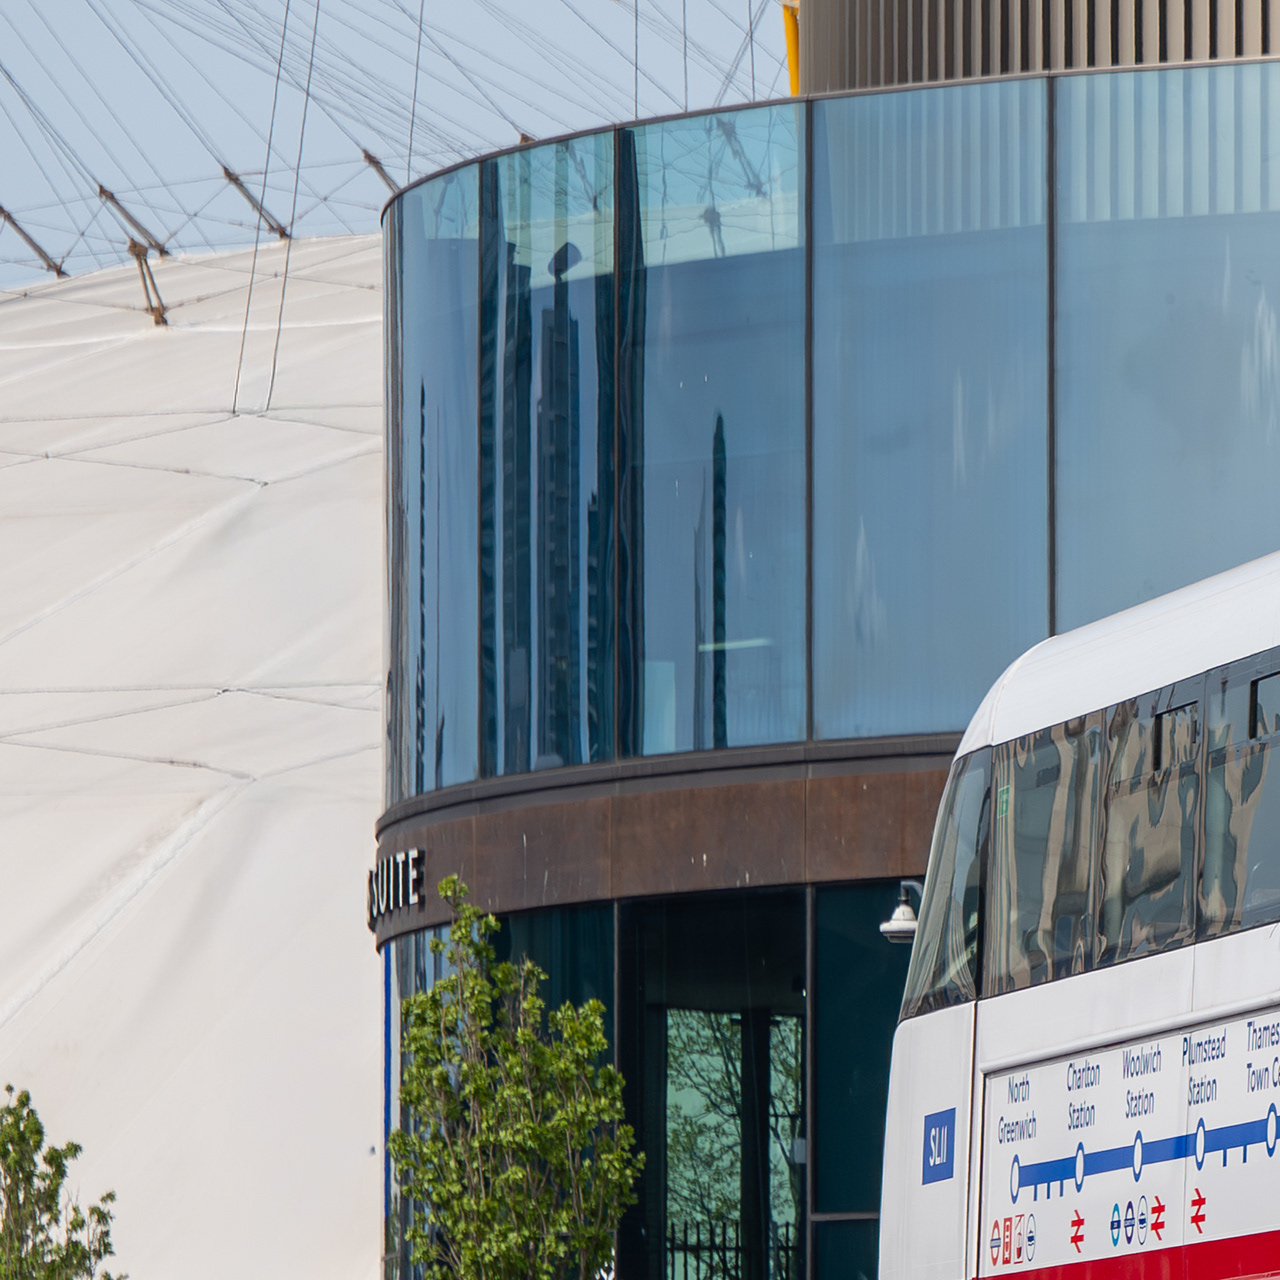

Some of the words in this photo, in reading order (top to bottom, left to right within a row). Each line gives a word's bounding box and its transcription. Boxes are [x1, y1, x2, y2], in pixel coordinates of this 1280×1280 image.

[367, 847, 418, 918] SUITE
[1122, 1043, 1162, 1080] Woolwich
[1182, 1028, 1226, 1067] Plumstead
[1008, 1073, 1030, 1104] North
[1067, 1059, 1100, 1091] Charlton
[1187, 1074, 1217, 1107] Station
[1247, 1061, 1270, 1093] Town
[1067, 1100, 1095, 1130] Station
[1125, 1089, 1155, 1119] Station
[998, 1110, 1037, 1145] Greenwich
[929, 1125, 948, 1167] SL11
